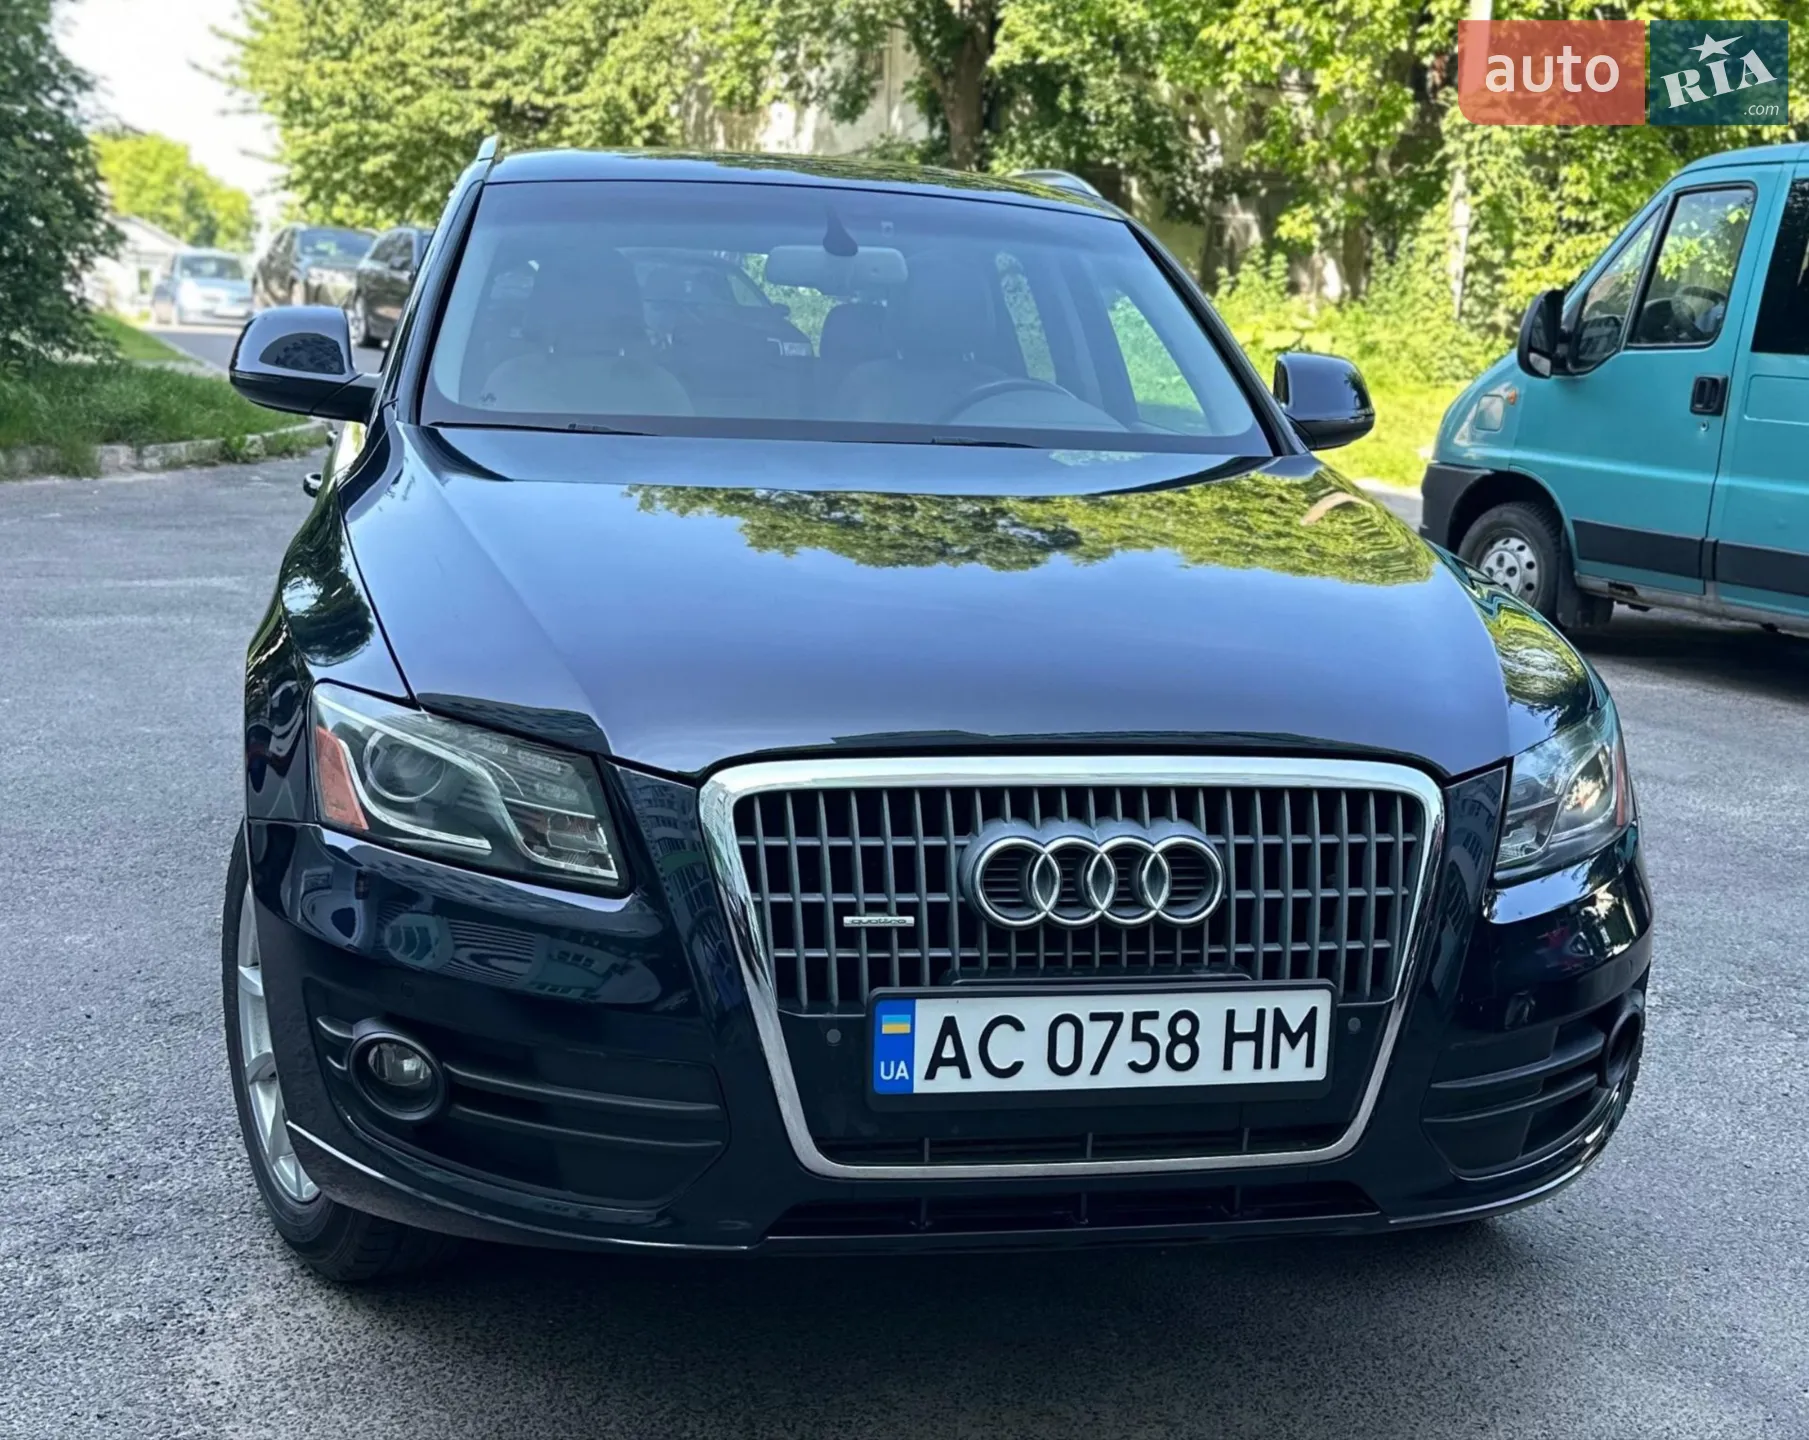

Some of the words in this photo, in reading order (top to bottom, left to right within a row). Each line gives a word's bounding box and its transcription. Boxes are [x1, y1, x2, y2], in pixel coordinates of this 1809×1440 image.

[849, 917, 908, 926] quattro
[923, 1014, 1026, 1081] AC
[1046, 1009, 1200, 1076] 0758
[1222, 1005, 1319, 1071] HM
[880, 1060, 910, 1081] UA
